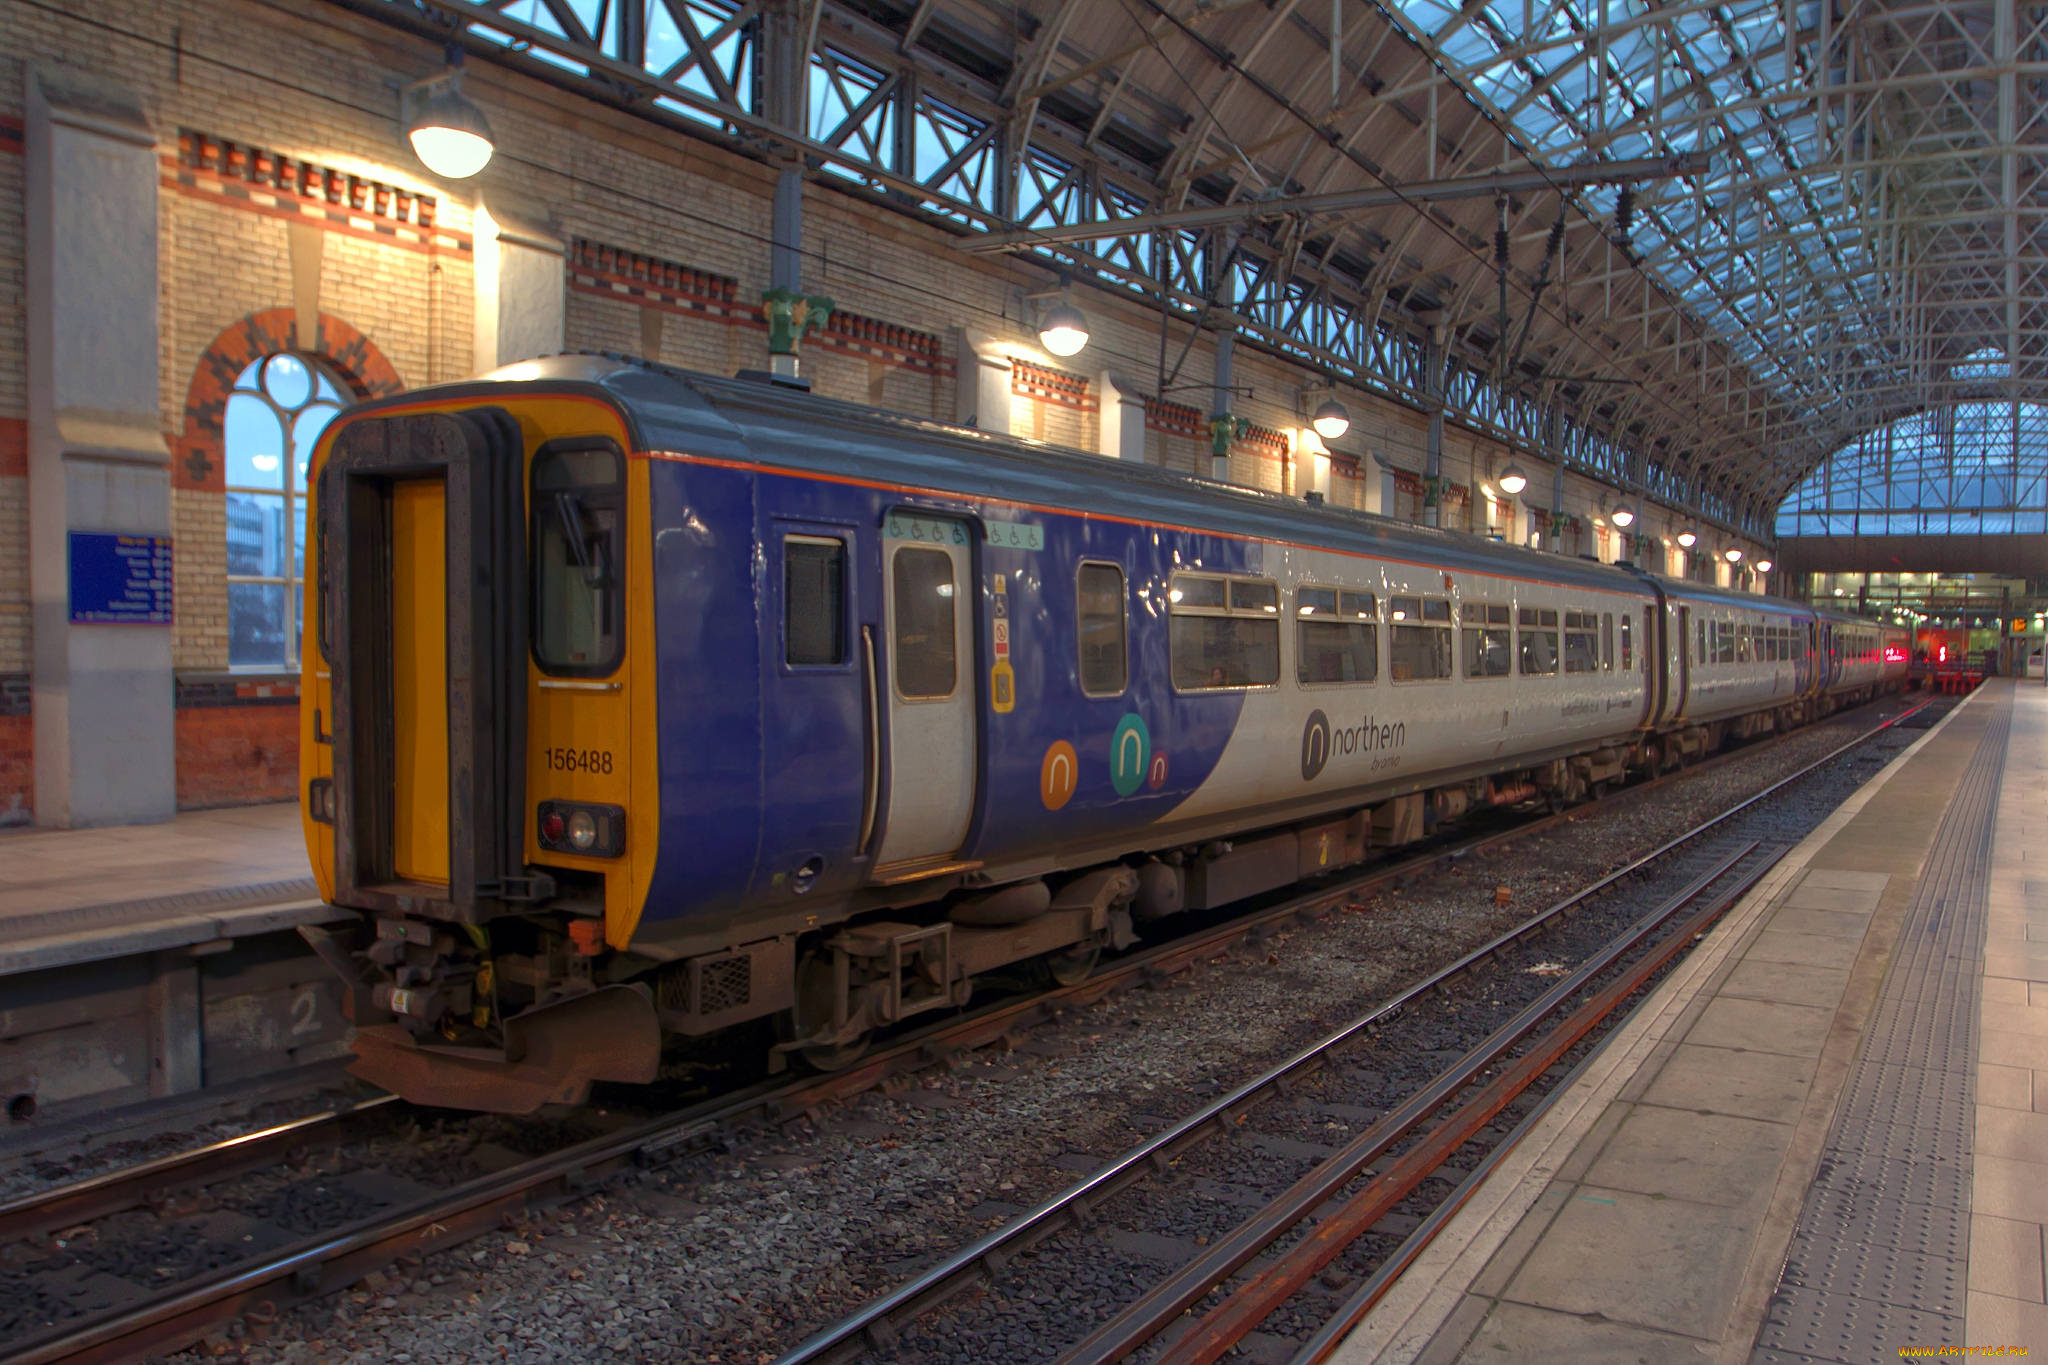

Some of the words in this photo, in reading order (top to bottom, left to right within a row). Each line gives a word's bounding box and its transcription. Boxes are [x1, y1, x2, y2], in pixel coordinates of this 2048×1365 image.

[1332, 715, 1405, 756] northern
[545, 747, 613, 775] 156488
[290, 990, 322, 1035] 2
